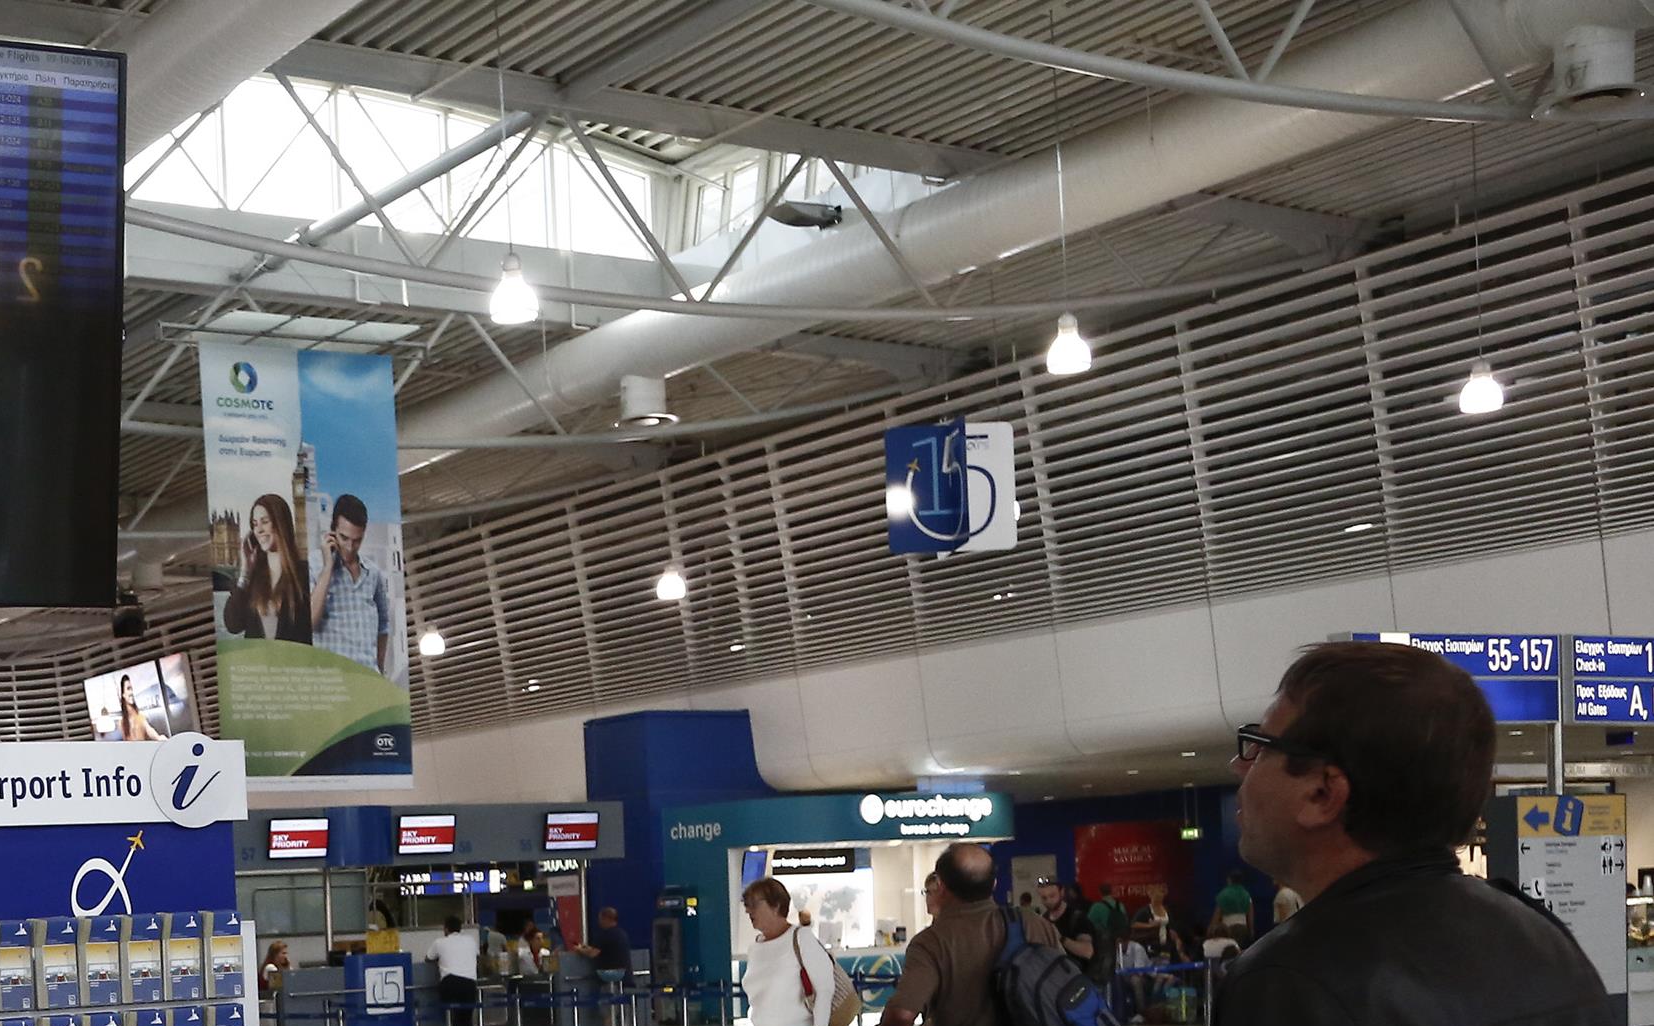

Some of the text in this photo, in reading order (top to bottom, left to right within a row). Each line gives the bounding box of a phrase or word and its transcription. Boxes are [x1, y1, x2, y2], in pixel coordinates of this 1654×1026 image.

[1487, 638, 1554, 672] 55-157
[1575, 658, 1606, 672] Check-in
[1576, 684, 1595, 700] Προς
[1577, 702, 1608, 716] All Gates
[82, 766, 142, 798] Info
[884, 794, 993, 821] eurochange
[272, 833, 289, 841] SKY
[401, 830, 418, 838] SKY
[549, 833, 581, 841] PRIORITY
[670, 821, 722, 841] change
[272, 839, 309, 848] PRIORITY
[401, 836, 436, 845] PRIORITY
